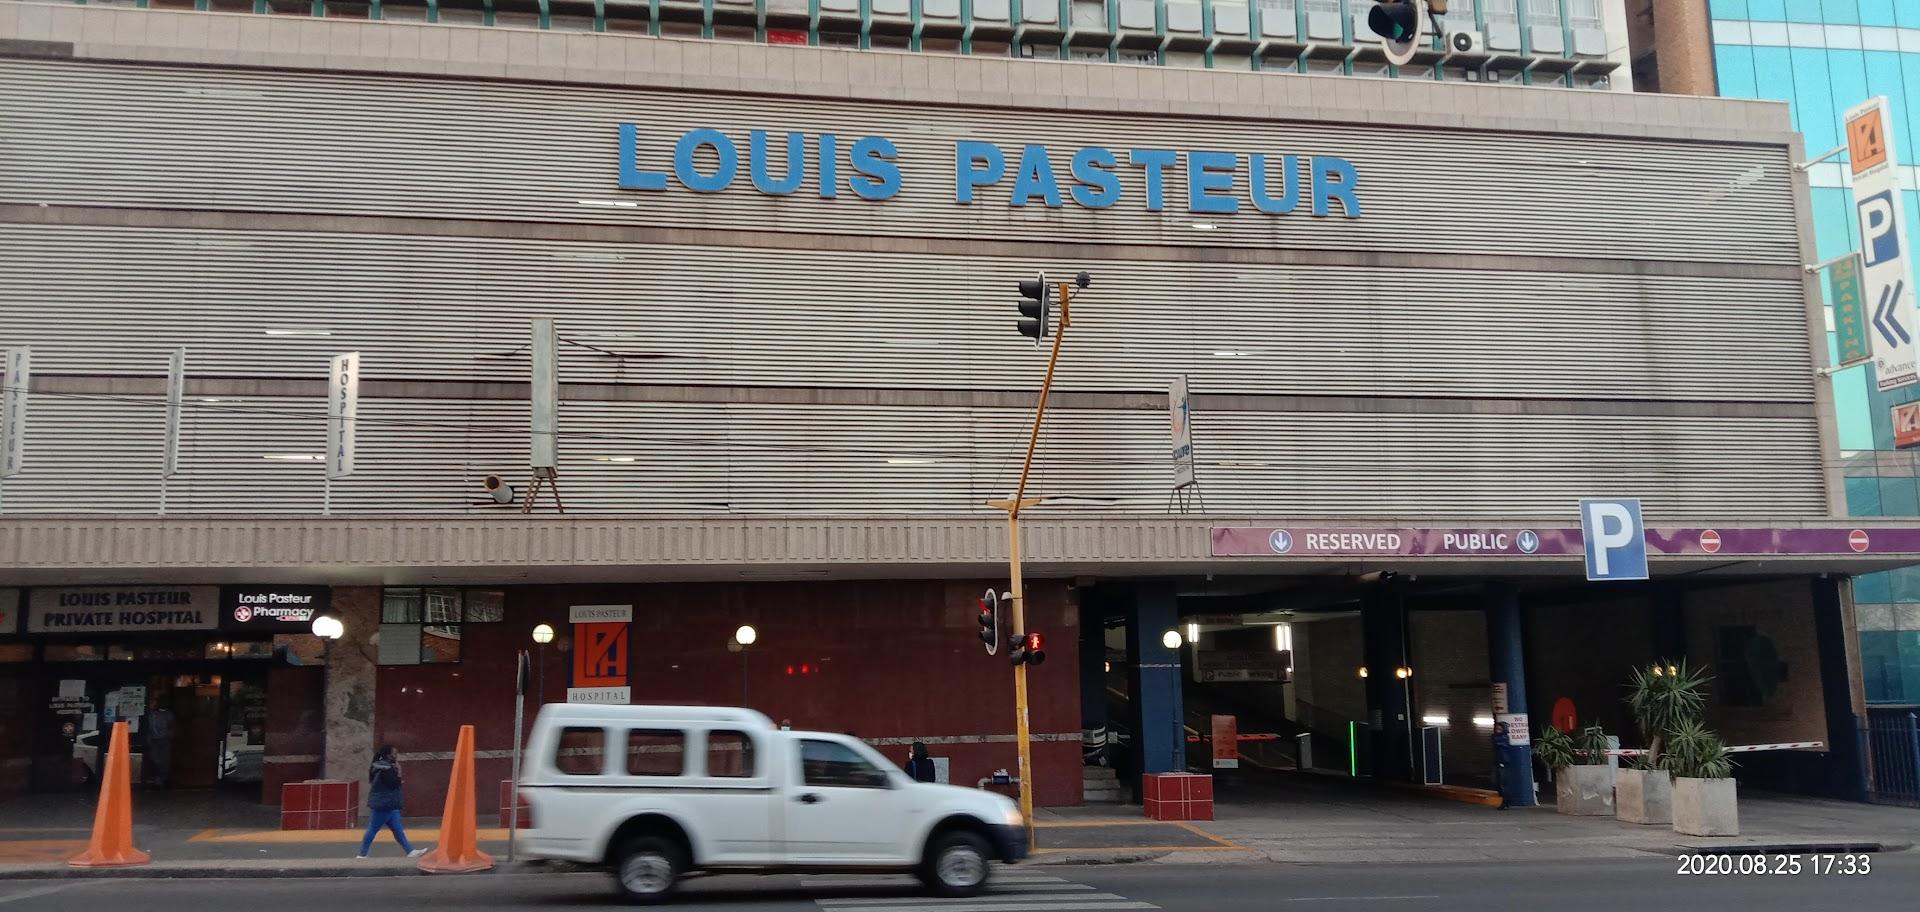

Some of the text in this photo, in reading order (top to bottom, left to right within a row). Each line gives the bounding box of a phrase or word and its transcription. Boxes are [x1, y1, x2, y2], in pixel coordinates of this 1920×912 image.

[618, 123, 1361, 218] LOUIS PASTEUR
[1859, 197, 1893, 264] P
[337, 359, 349, 471] HOSPITAL
[1306, 533, 1508, 550] RESERVED PUBLIC
[1589, 503, 1634, 575] P
[59, 591, 192, 606] LOUIS PASTEUR
[239, 594, 312, 603] Louis Pasteur
[43, 610, 203, 626] PRIVATE HOSPITAL
[253, 607, 314, 620] Pharmacy
[573, 692, 625, 700] HOSPITAL
